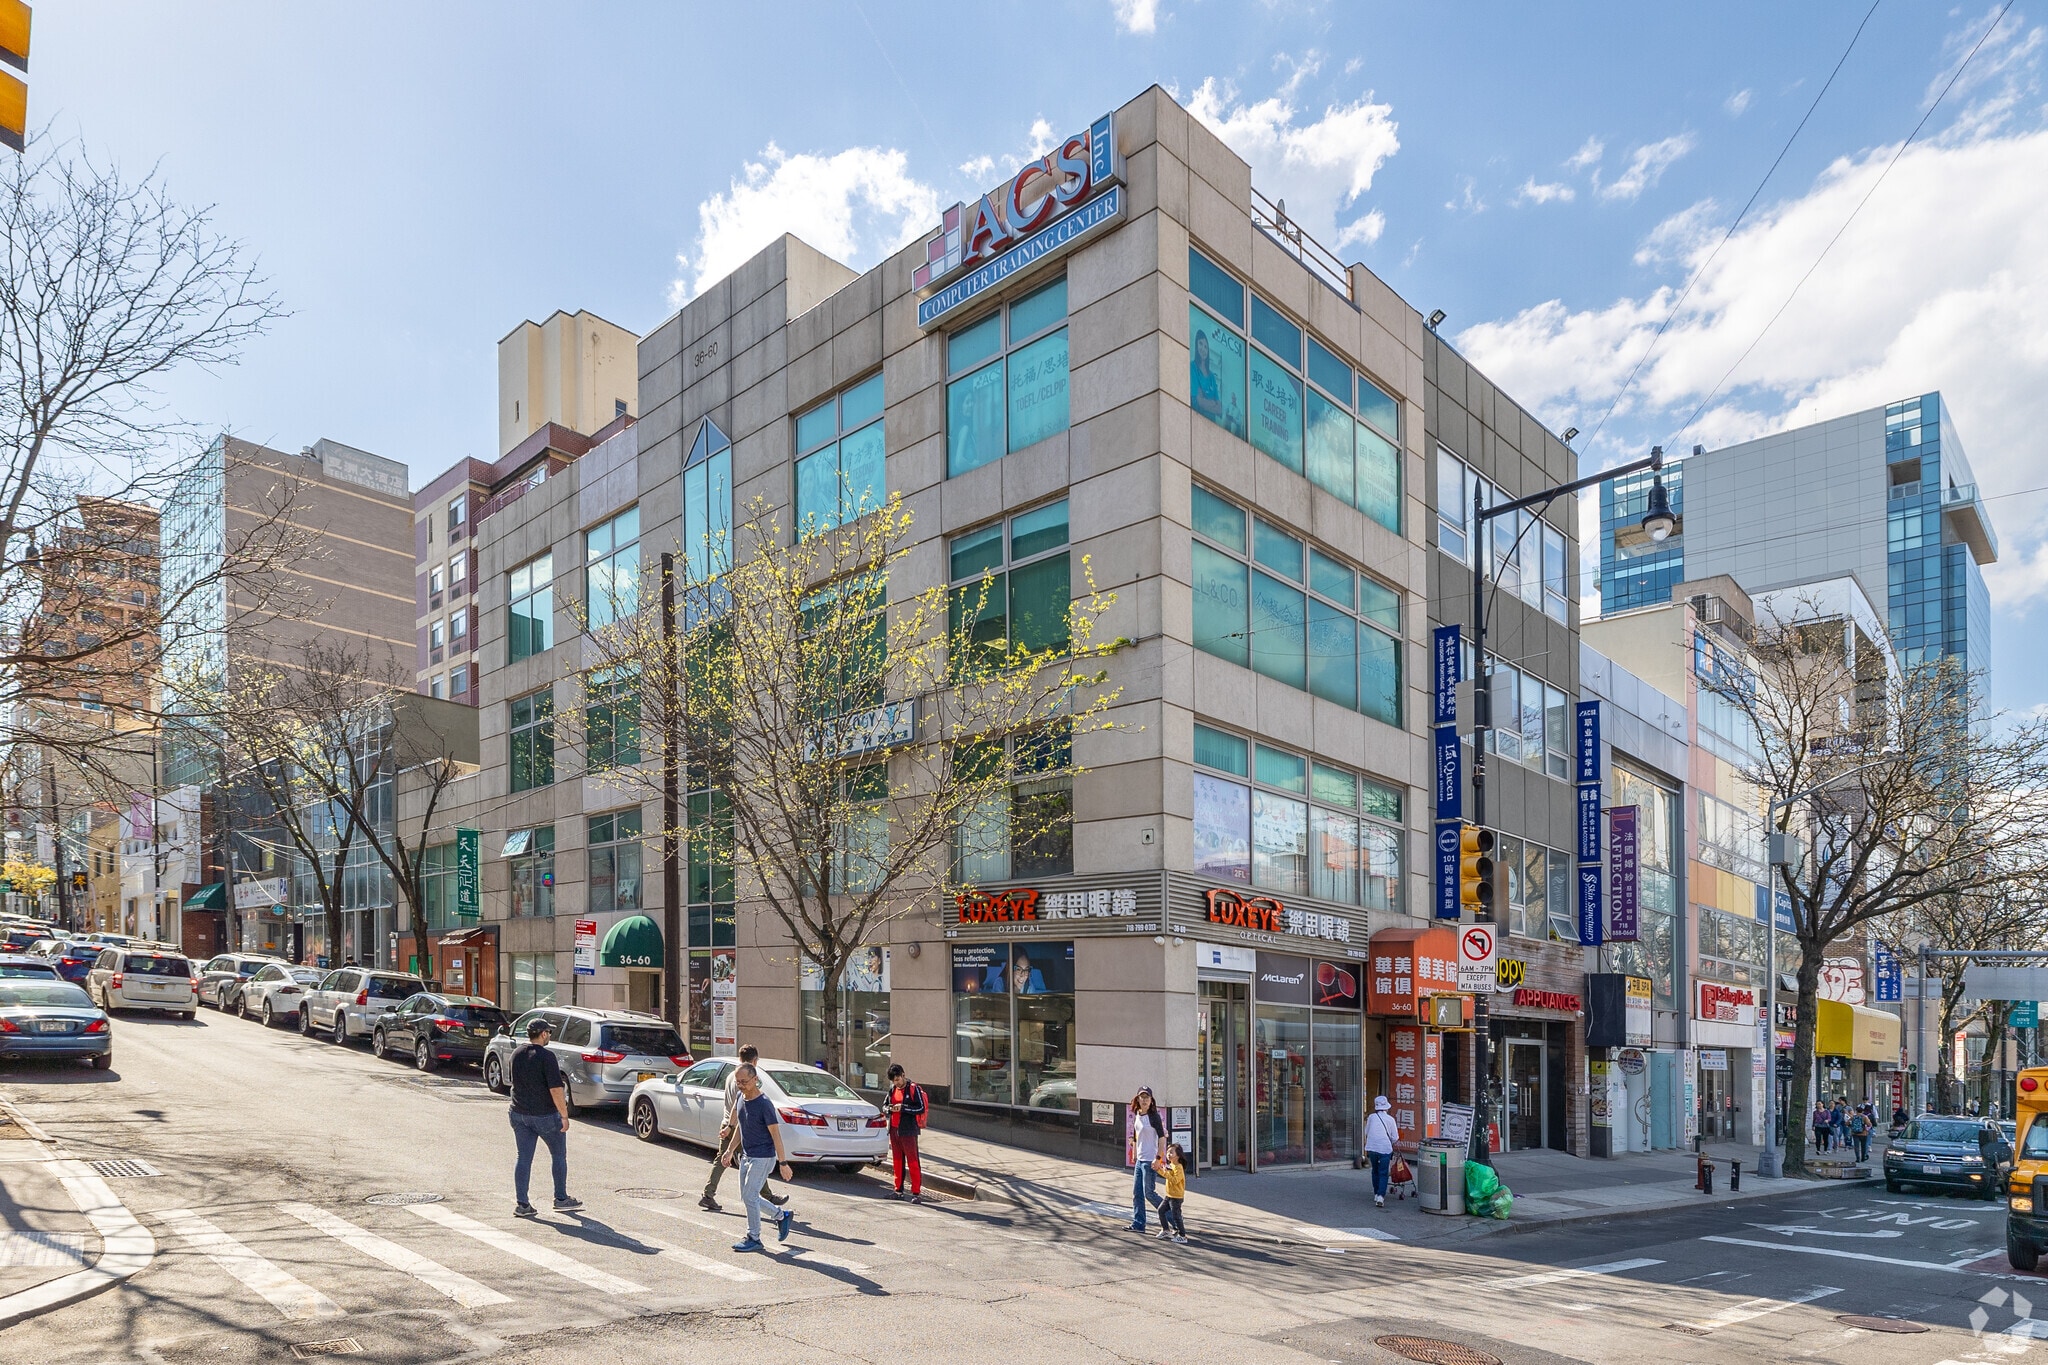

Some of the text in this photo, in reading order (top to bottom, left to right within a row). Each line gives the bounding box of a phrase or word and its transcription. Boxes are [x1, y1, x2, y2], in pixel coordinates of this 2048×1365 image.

[1093, 123, 1109, 182] Inc.
[963, 132, 1090, 268] ACS
[924, 196, 1115, 320] COMPUTER TRAINING CENTER
[694, 341, 719, 368] 36-60
[1015, 378, 1067, 413] TOEFL/CELPIP
[1263, 397, 1287, 425] CAREER
[1260, 413, 1290, 442] TRAINING
[1443, 743, 1456, 801] La Queen
[1442, 854, 1456, 863] 101
[1233, 869, 1247, 879] 2FL
[1044, 888, 1138, 920] 樂思眼鏡
[1587, 883, 1596, 901] Skin
[957, 888, 1040, 924] LUXEYE
[1205, 888, 1284, 932] LUXEYE
[998, 924, 1042, 934] OPTICAL
[1288, 909, 1351, 944] 樂思眼鏡
[1586, 901, 1596, 942] Sanctuary
[967, 946, 996, 955] protection,
[1239, 930, 1277, 945] OPTICAL
[619, 954, 651, 966] 36-60
[964, 954, 990, 962] reflection.
[1375, 956, 1412, 974] 華美
[1497, 957, 1527, 985] ppy
[1261, 973, 1302, 985] McLaren
[1473, 983, 1492, 991] BUSES
[1391, 1003, 1412, 1011] 36-60
[1516, 989, 1581, 1011] APPLIANCES
